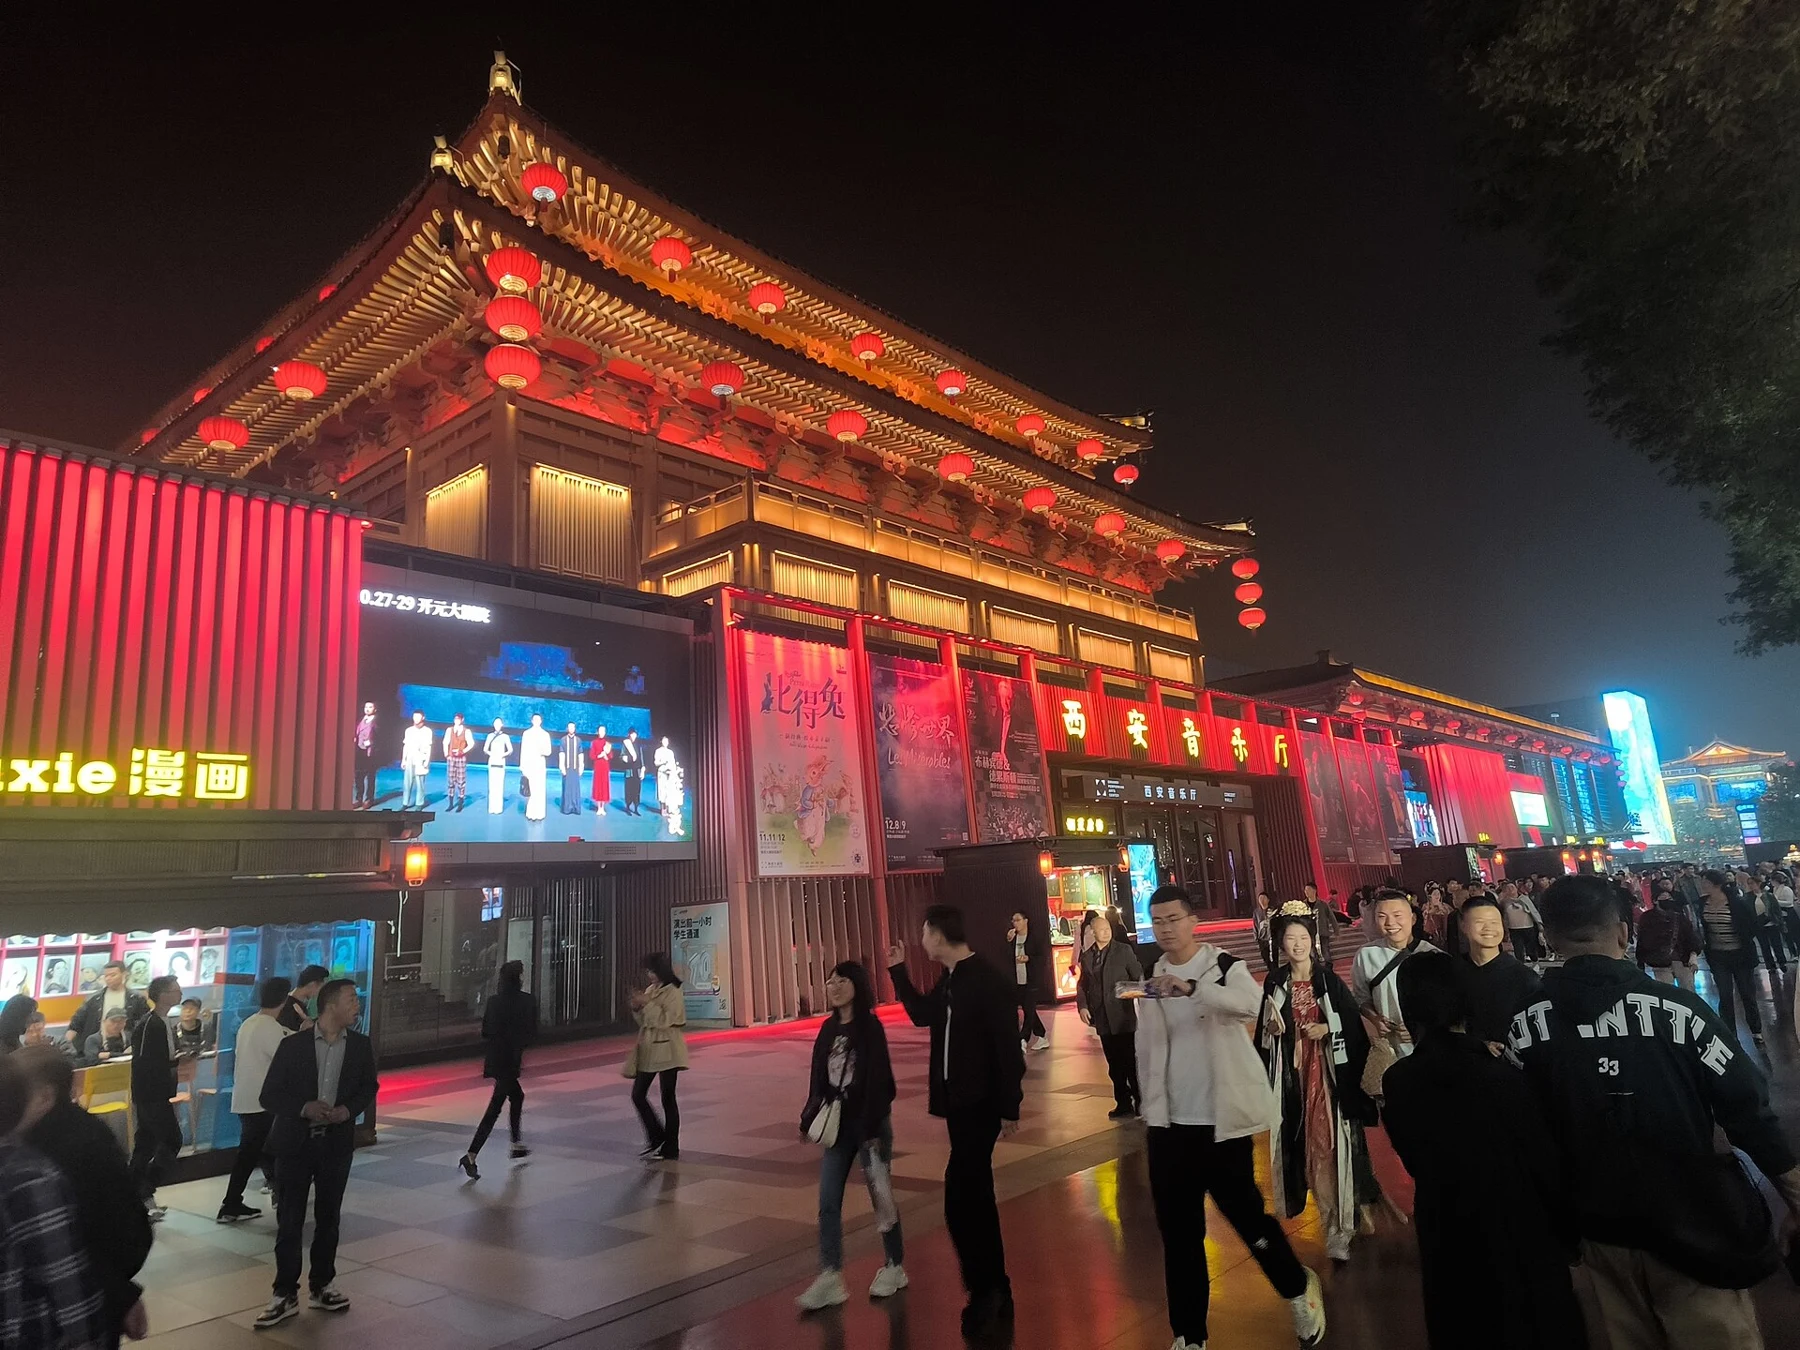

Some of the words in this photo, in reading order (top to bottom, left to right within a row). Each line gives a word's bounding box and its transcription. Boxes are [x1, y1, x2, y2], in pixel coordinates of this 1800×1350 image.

[760, 672, 846, 729] 比得兔
[1061, 699, 1289, 768] 西安音乐厅
[0, 752, 117, 794] xie
[129, 748, 248, 799] 漫画
[1143, 784, 1197, 801] 西安音乐厅
[1598, 1056, 1620, 1077] 33
